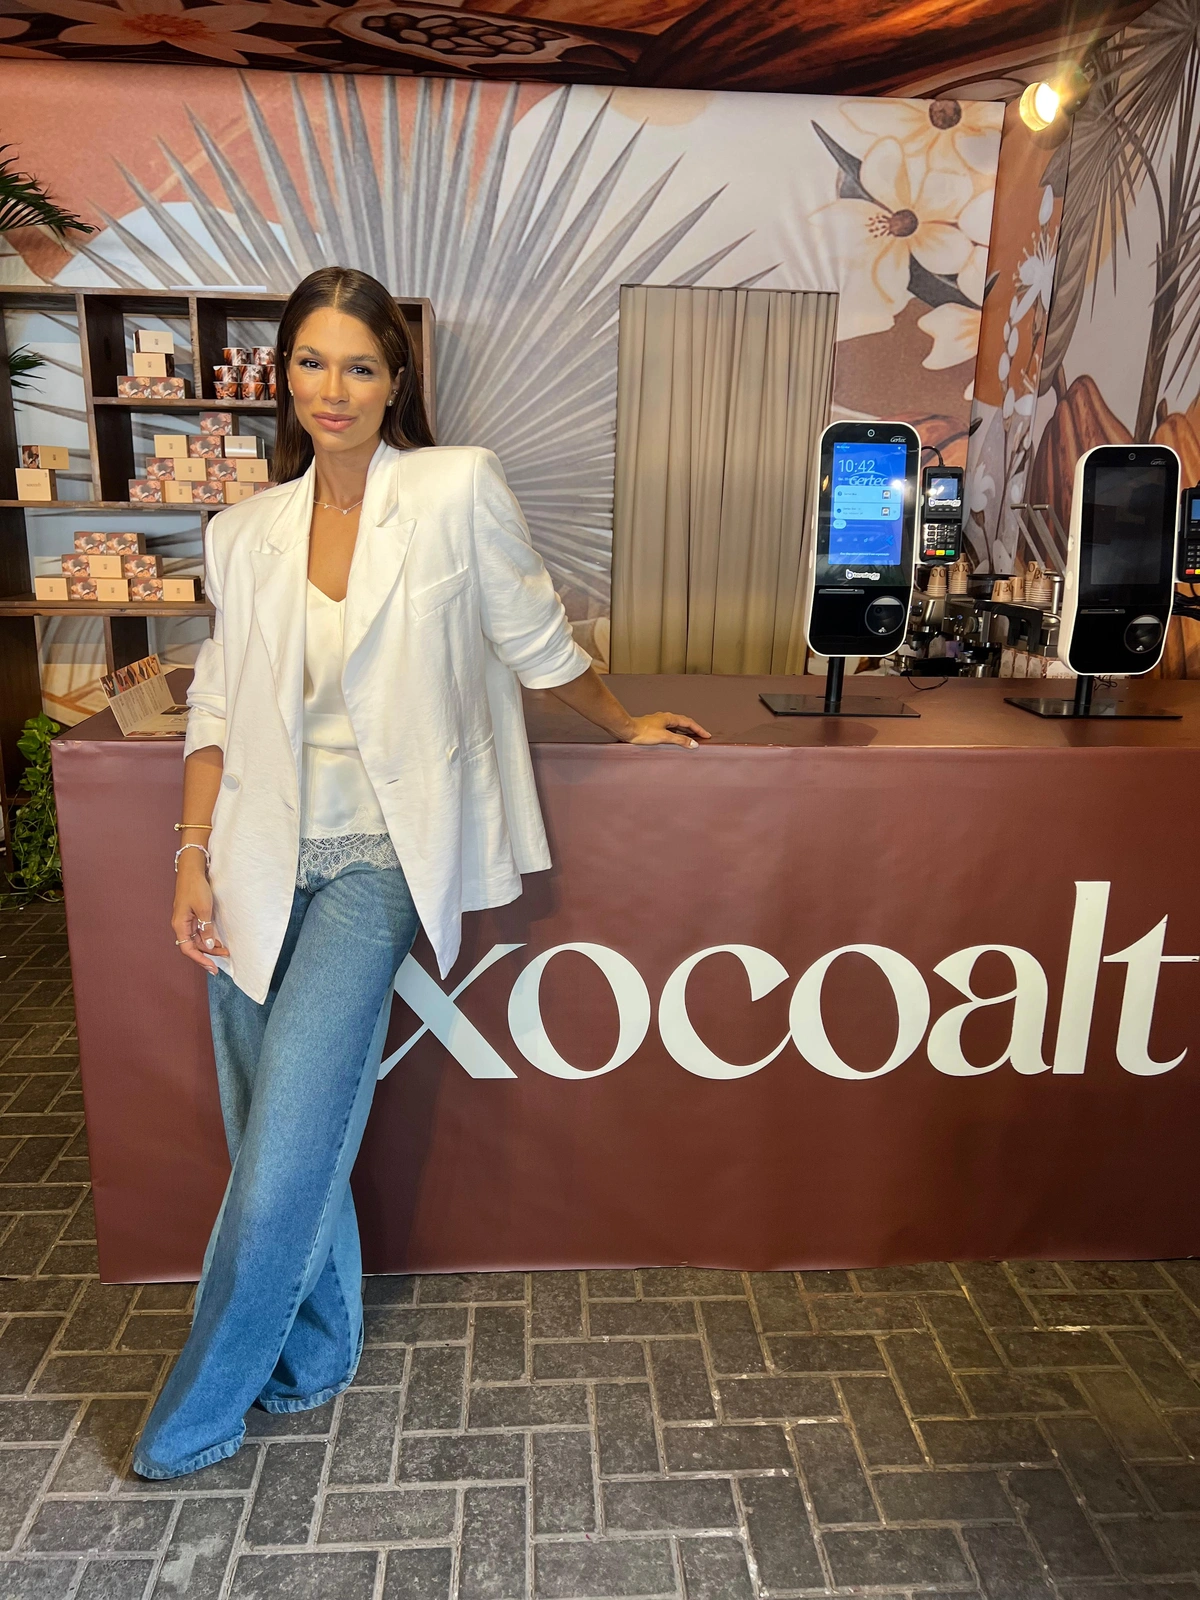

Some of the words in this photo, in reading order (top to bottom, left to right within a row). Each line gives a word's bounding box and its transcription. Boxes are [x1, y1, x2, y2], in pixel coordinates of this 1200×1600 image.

[838, 459, 876, 473] 10:42
[849, 473, 889, 486] Gertec
[376, 880, 1200, 1080] xocoalt
